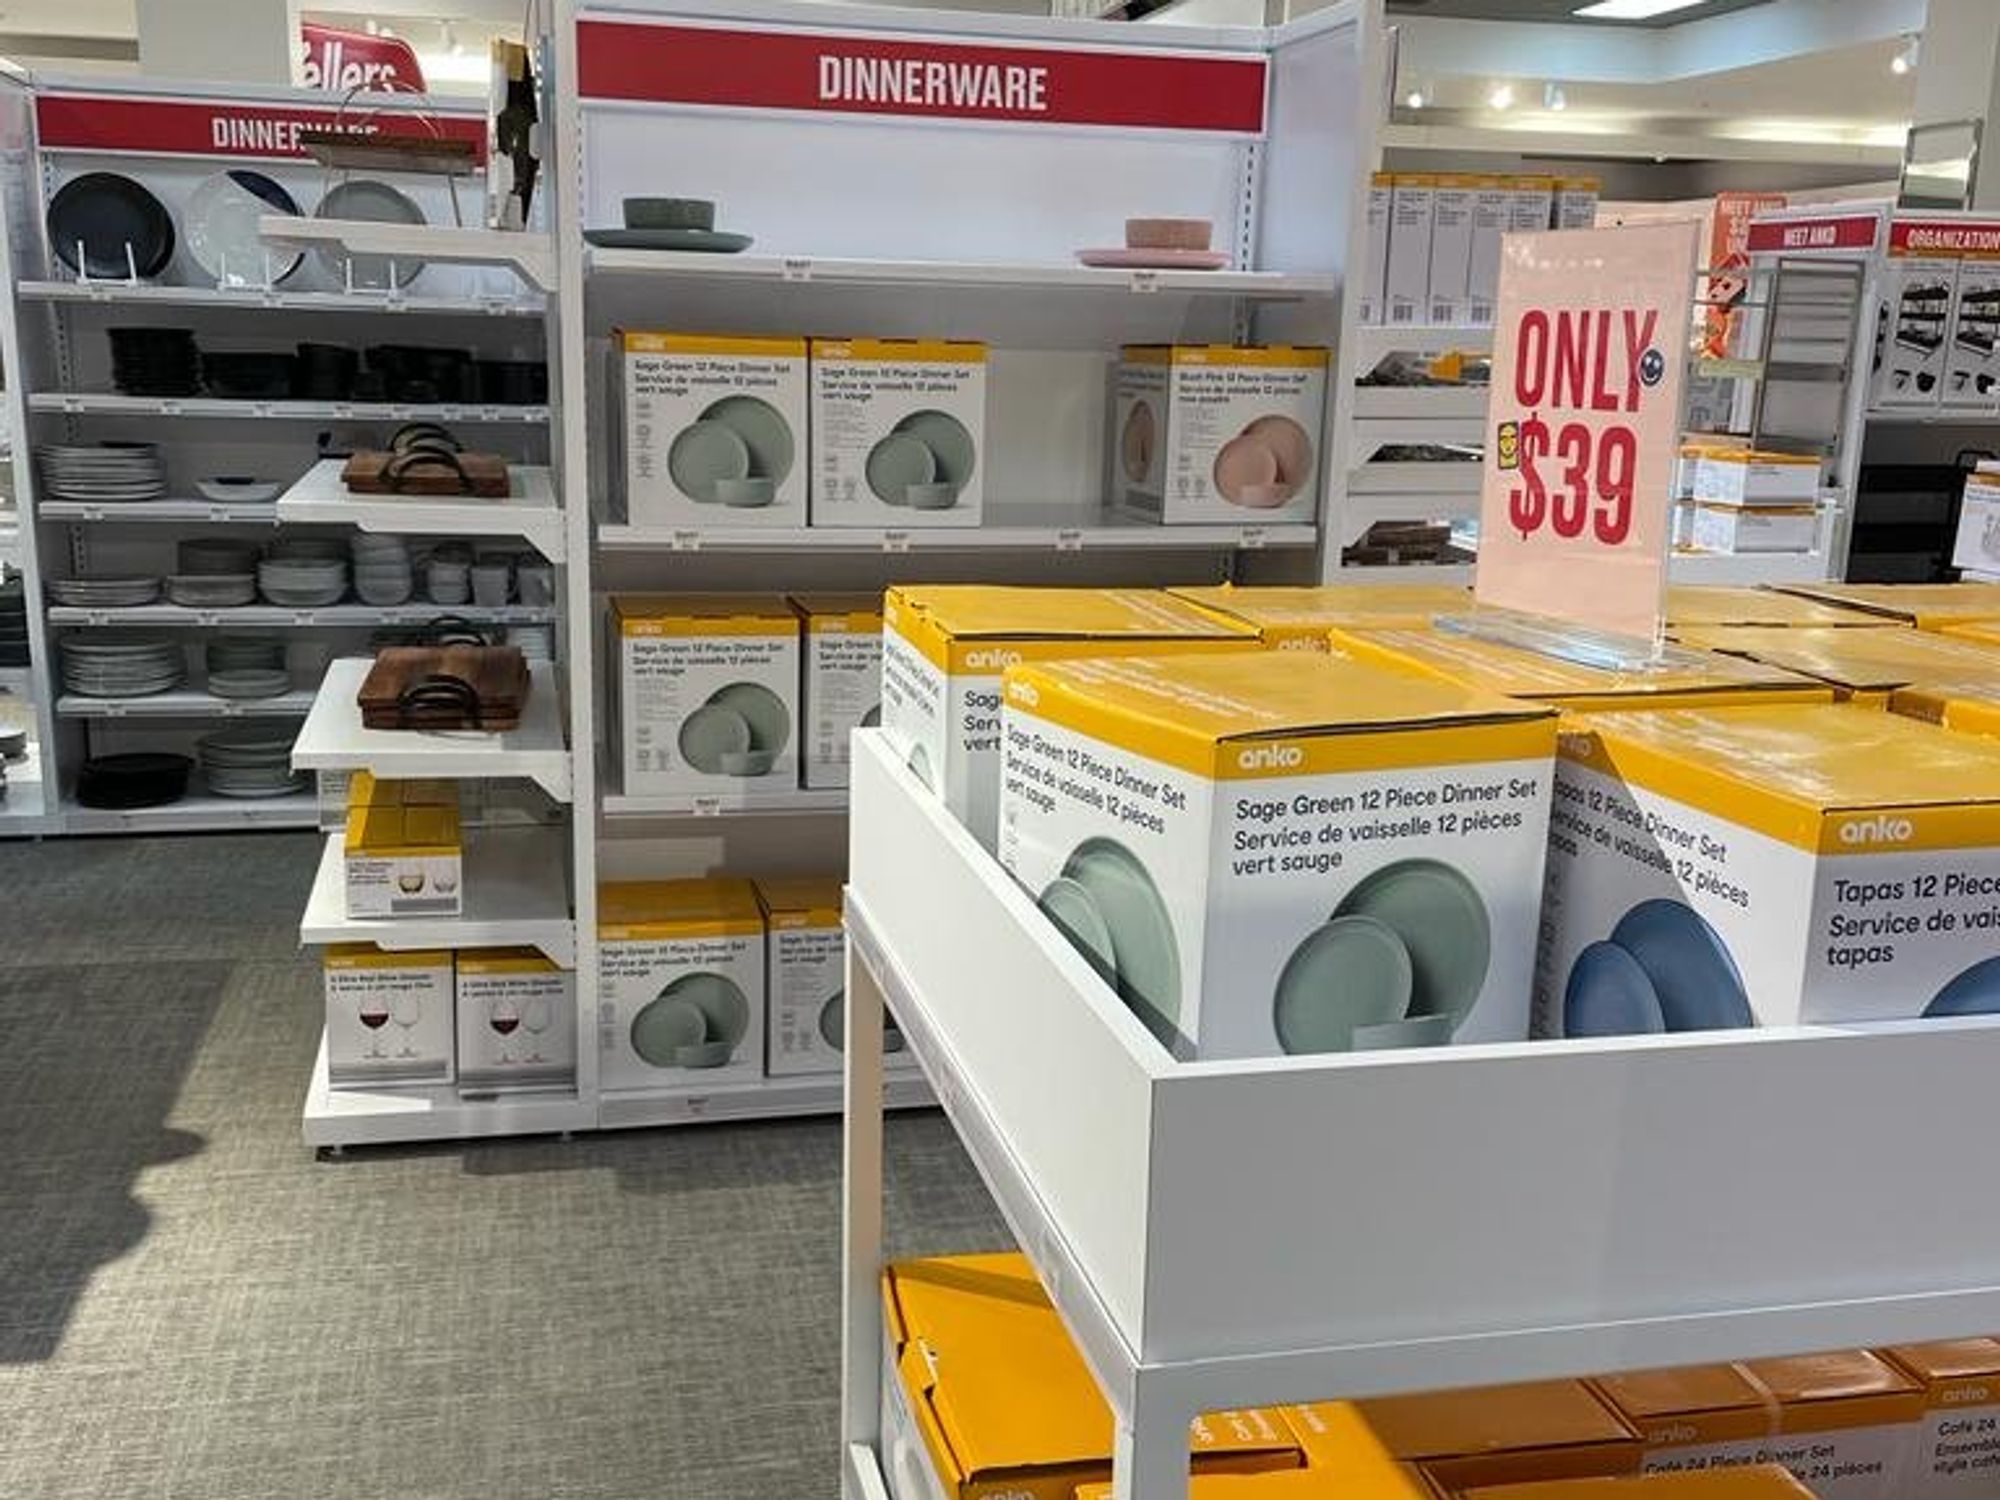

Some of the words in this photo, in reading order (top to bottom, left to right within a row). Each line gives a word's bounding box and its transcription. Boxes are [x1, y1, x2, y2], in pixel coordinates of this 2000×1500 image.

[302, 41, 396, 93] ellers
[819, 54, 1048, 113] DINNERWARE
[211, 117, 379, 151] DINNER
[1514, 308, 1658, 413] ONLY
[1509, 411, 1637, 546] $39
[965, 648, 1023, 669] anko
[963, 690, 1003, 712] Sag
[1033, 733, 1065, 762] Green
[1066, 748, 1080, 770] 12
[1081, 754, 1113, 783] Piece
[1114, 766, 1159, 800] Dinner
[1161, 783, 1187, 811] Set
[1238, 744, 1303, 770] anko
[1106, 794, 1119, 817] 12
[1236, 799, 1287, 824] Sage
[1292, 794, 1355, 816] Green
[1360, 789, 1381, 811] 12
[1385, 786, 1438, 808] Piece
[1442, 782, 1504, 804] Dinner
[1507, 778, 1537, 799] Set
[1234, 826, 1313, 851] Service
[1317, 823, 1343, 844] de
[1348, 816, 1432, 841] vaisselle
[1437, 812, 1458, 834] 12
[1461, 809, 1523, 837] pièces
[1588, 790, 1603, 813] 12
[1604, 796, 1644, 829] Piece
[1645, 812, 1697, 851] Dinner
[1698, 833, 1728, 864] Set
[1839, 815, 1914, 844] anko
[1550, 809, 1593, 840] ervice
[1593, 826, 1612, 848] de
[1676, 859, 1694, 884] 12
[1232, 855, 1276, 876] vert
[1281, 852, 1343, 874] sauge
[1833, 878, 1905, 908] Tapas
[1912, 874, 1938, 898] 12
[1829, 911, 1921, 938] Service
[1926, 908, 1957, 932] de
[1826, 944, 1895, 970] tapas
[1808, 1445, 1835, 1458] Set
[1809, 1466, 1830, 1480] 24
